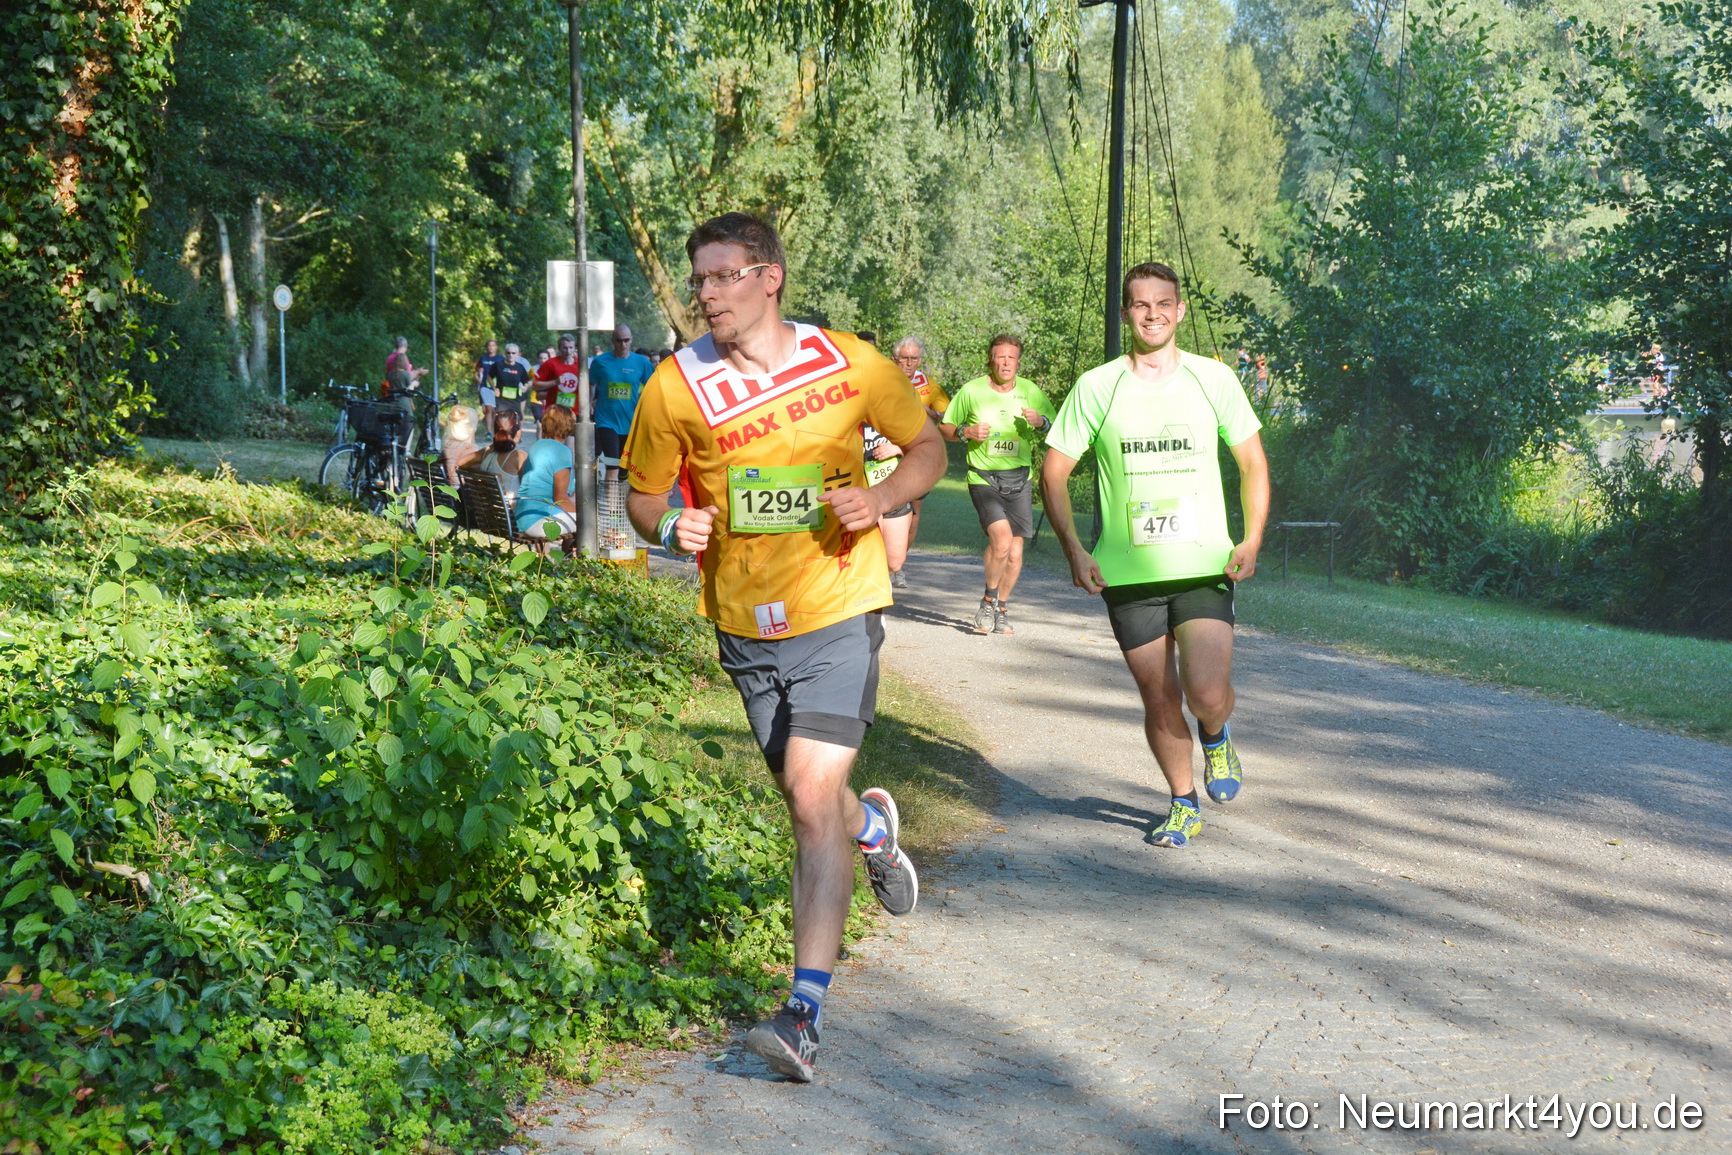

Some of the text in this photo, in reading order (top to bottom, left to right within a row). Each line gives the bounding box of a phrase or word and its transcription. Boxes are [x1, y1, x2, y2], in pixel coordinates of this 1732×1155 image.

[715, 380, 860, 455] MAX BÖGL
[994, 441, 1014, 451] 440
[1120, 438, 1192, 454] BRANDL
[872, 465, 894, 480] 285
[741, 488, 812, 514] 1294
[776, 513, 801, 522] Ondrej
[1143, 515, 1180, 534] 476
